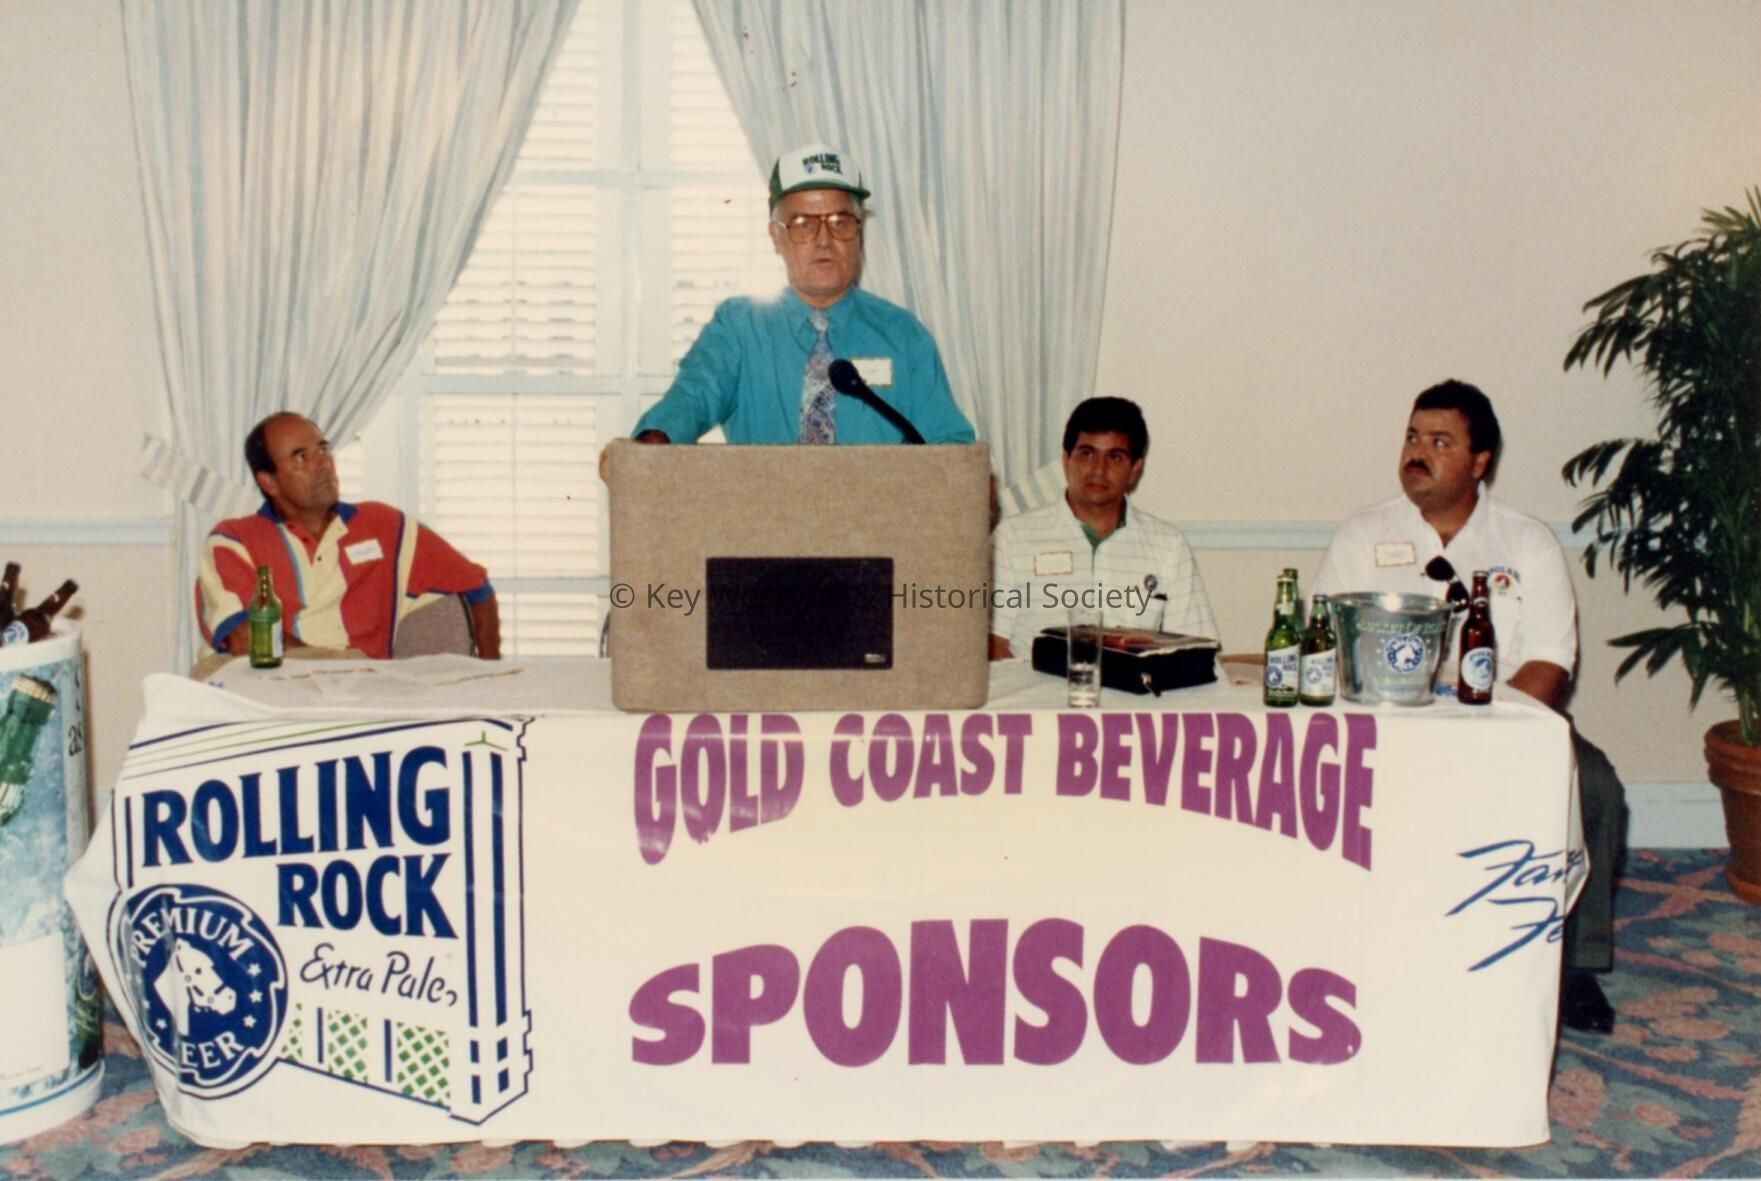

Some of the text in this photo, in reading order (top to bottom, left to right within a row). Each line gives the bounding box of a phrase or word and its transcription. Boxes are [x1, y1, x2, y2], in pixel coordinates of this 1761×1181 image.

[142, 747, 450, 867] ROLLING
[634, 713, 1377, 871] GOLD COAST BEVERAGE
[130, 906, 254, 969] PREMIUM
[277, 853, 458, 939] ROCK
[300, 942, 373, 992] Extra
[629, 918, 1362, 1067] SPONSORS
[181, 1030, 246, 1069] EER
